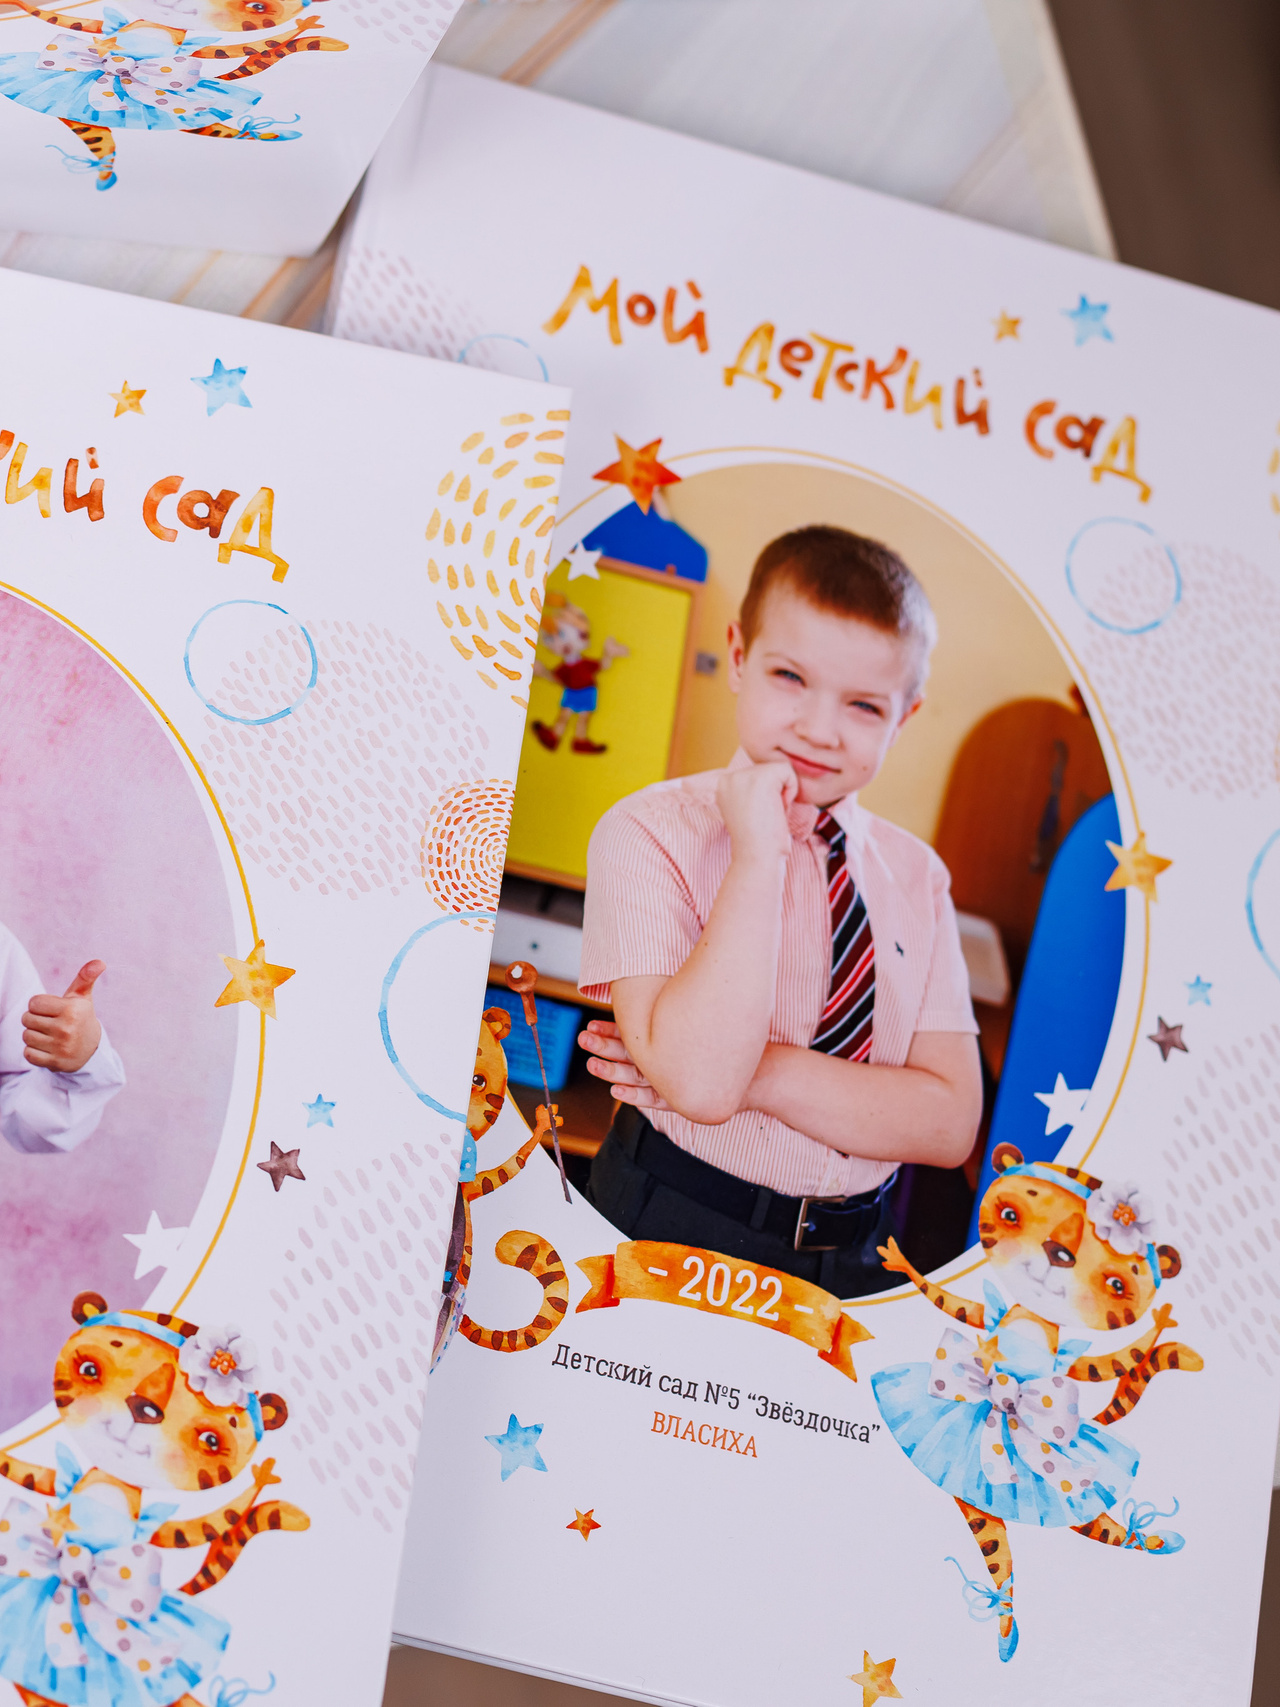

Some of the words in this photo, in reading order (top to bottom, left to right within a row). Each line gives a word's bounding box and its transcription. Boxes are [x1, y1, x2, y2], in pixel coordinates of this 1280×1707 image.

[678, 1255, 784, 1322] 2022
[551, 1343, 653, 1388] Детский
[658, 1374, 699, 1401] сад
[651, 1411, 758, 1459] ВЛАСИХА
